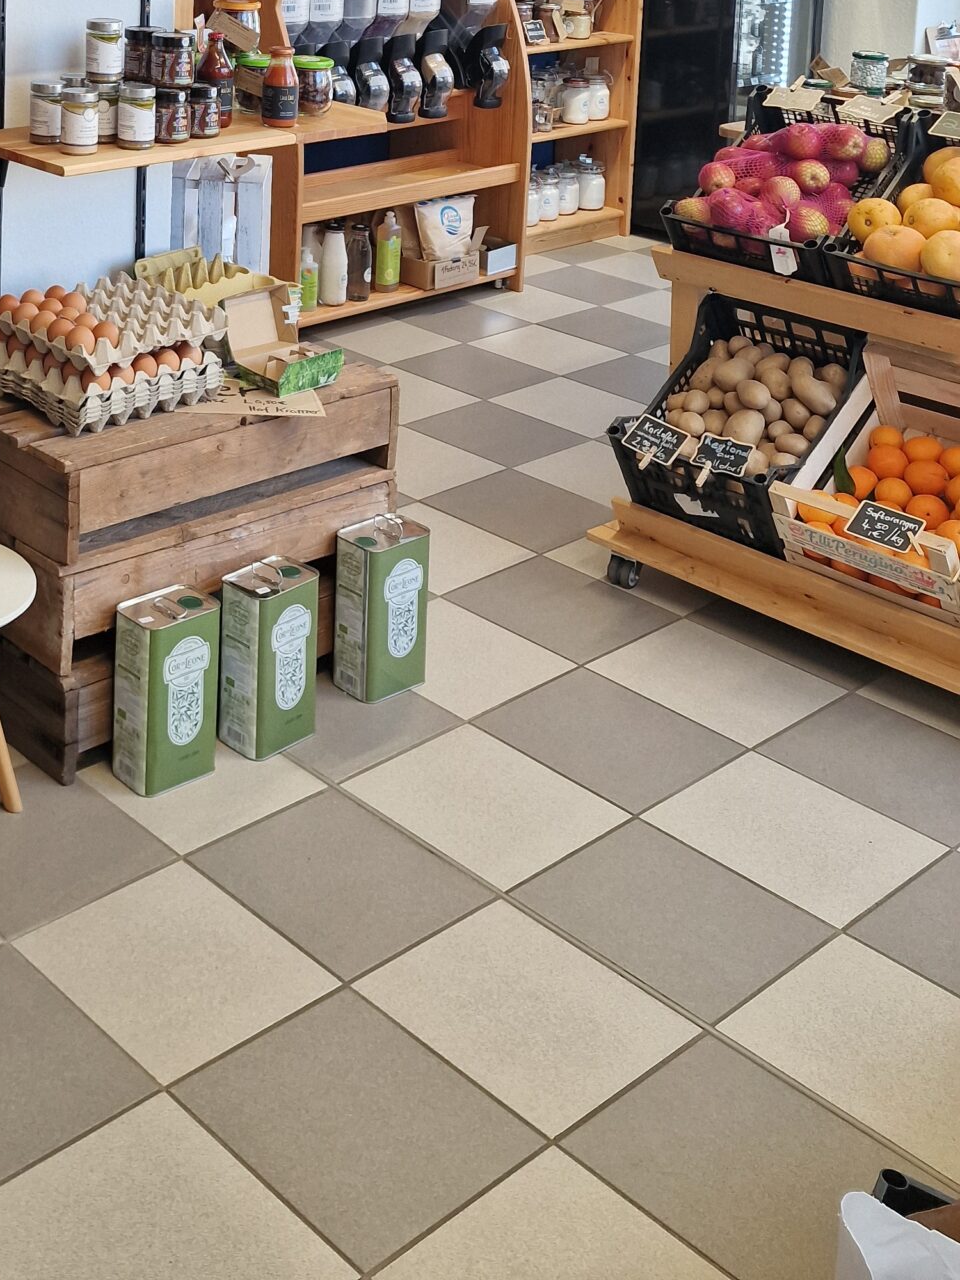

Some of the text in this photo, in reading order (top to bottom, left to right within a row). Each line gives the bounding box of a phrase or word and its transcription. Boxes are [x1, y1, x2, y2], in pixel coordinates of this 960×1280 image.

[704, 436, 751, 458] Regional
[716, 452, 735, 461] aus
[185, 653, 207, 669] LEONE
